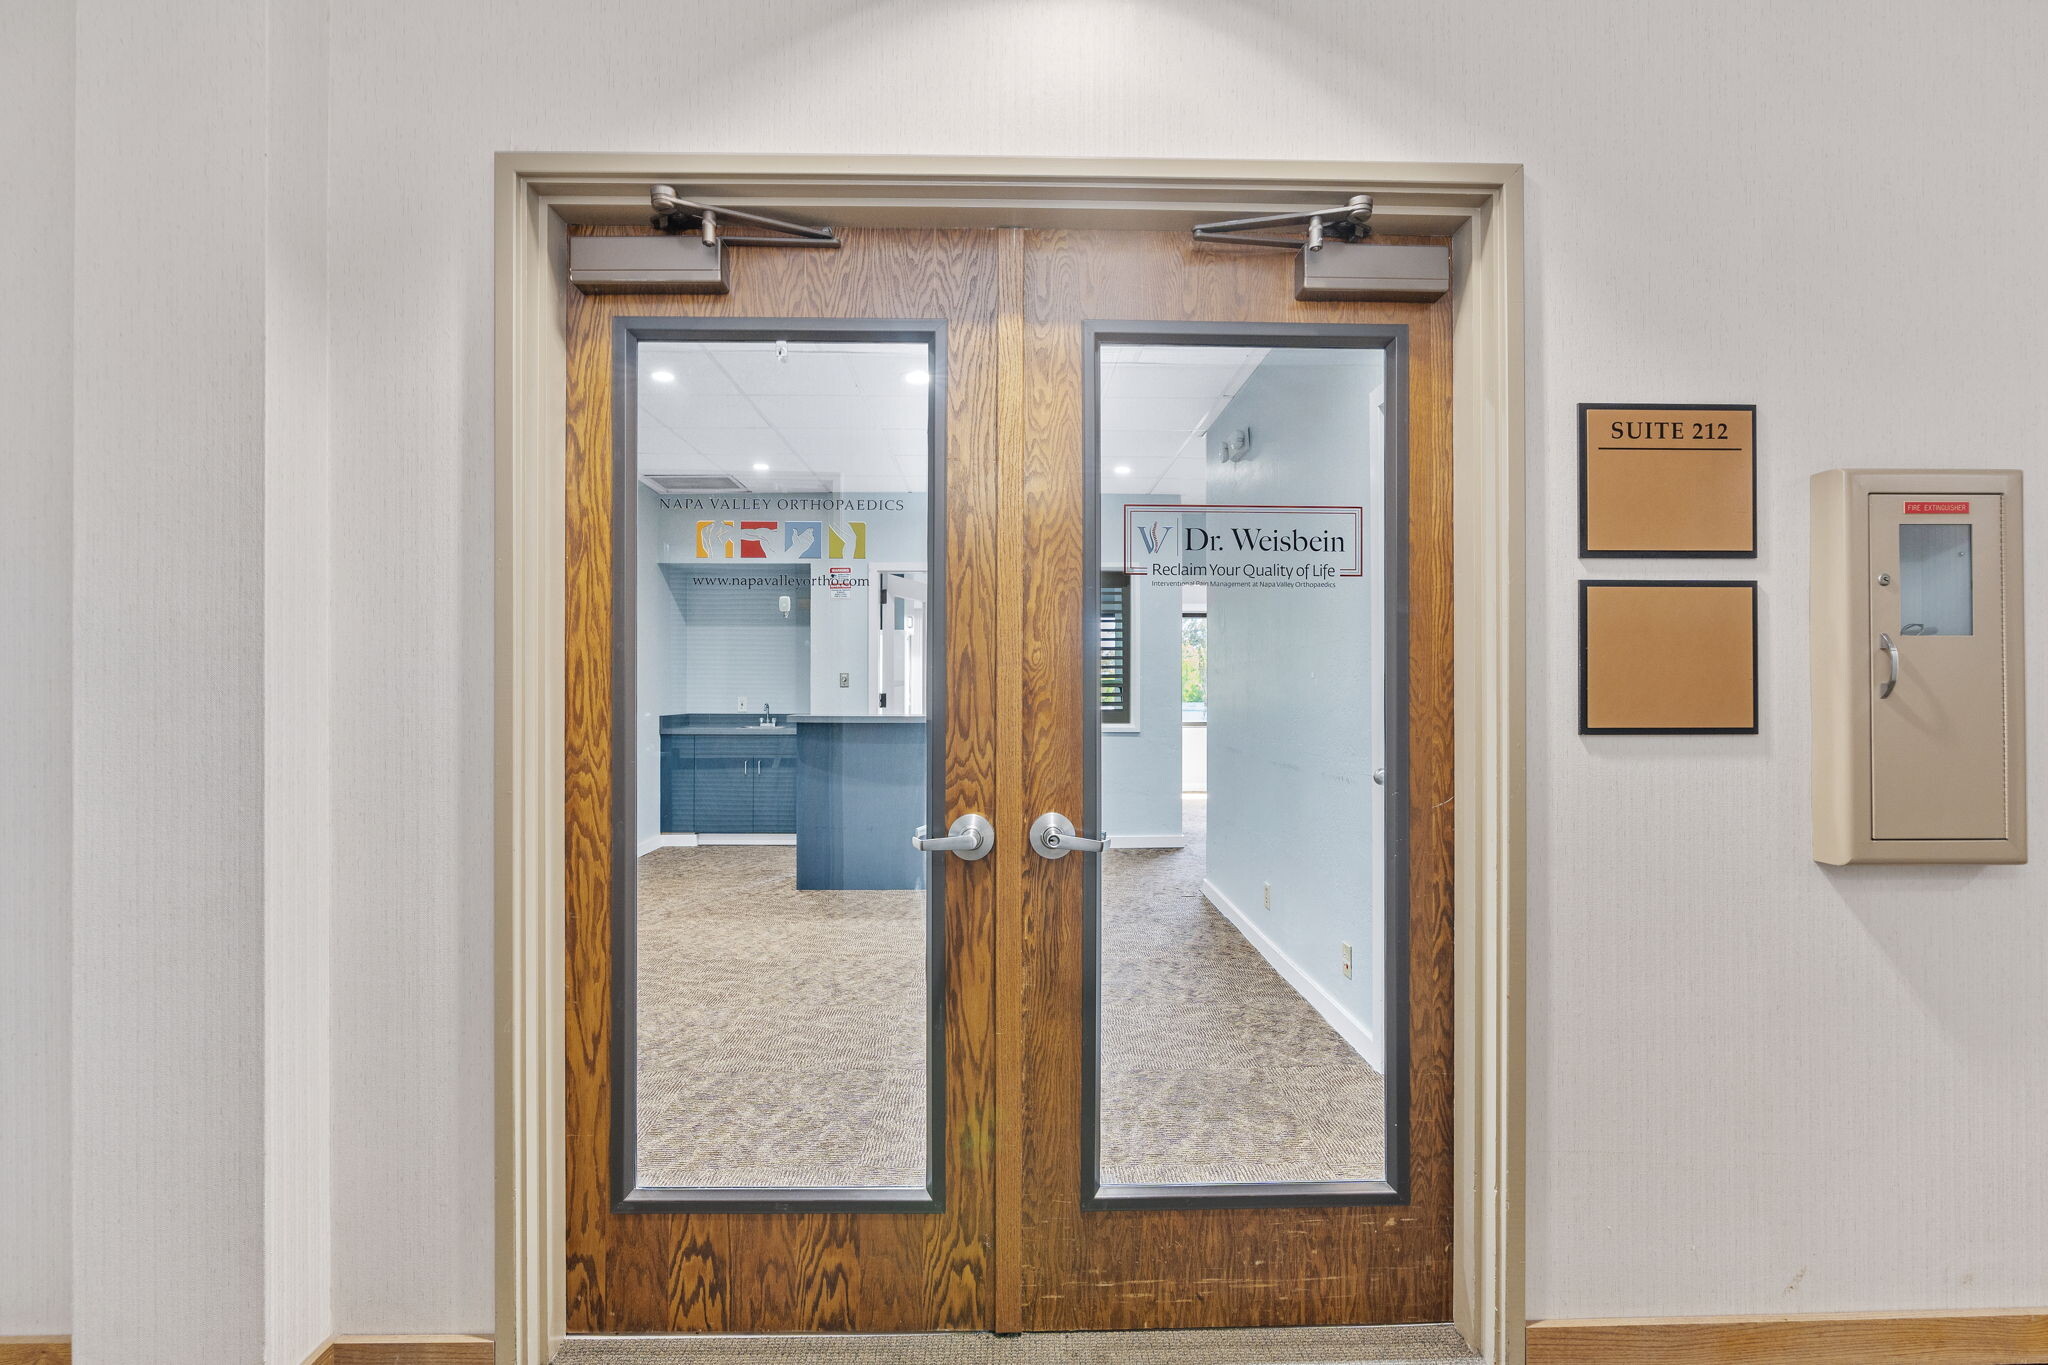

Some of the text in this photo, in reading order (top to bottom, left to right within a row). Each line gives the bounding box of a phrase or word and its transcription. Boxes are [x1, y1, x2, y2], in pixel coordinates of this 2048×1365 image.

[1611, 421, 1728, 440] SUITE 212
[660, 498, 905, 512] NAPA VALLEY ORTHOPAEDICS
[1185, 527, 1345, 552] Dr. Weisbein
[1152, 563, 1336, 580] Reclaim Your Quality of Life
[693, 575, 870, 590] www.napavalleyortho.com
